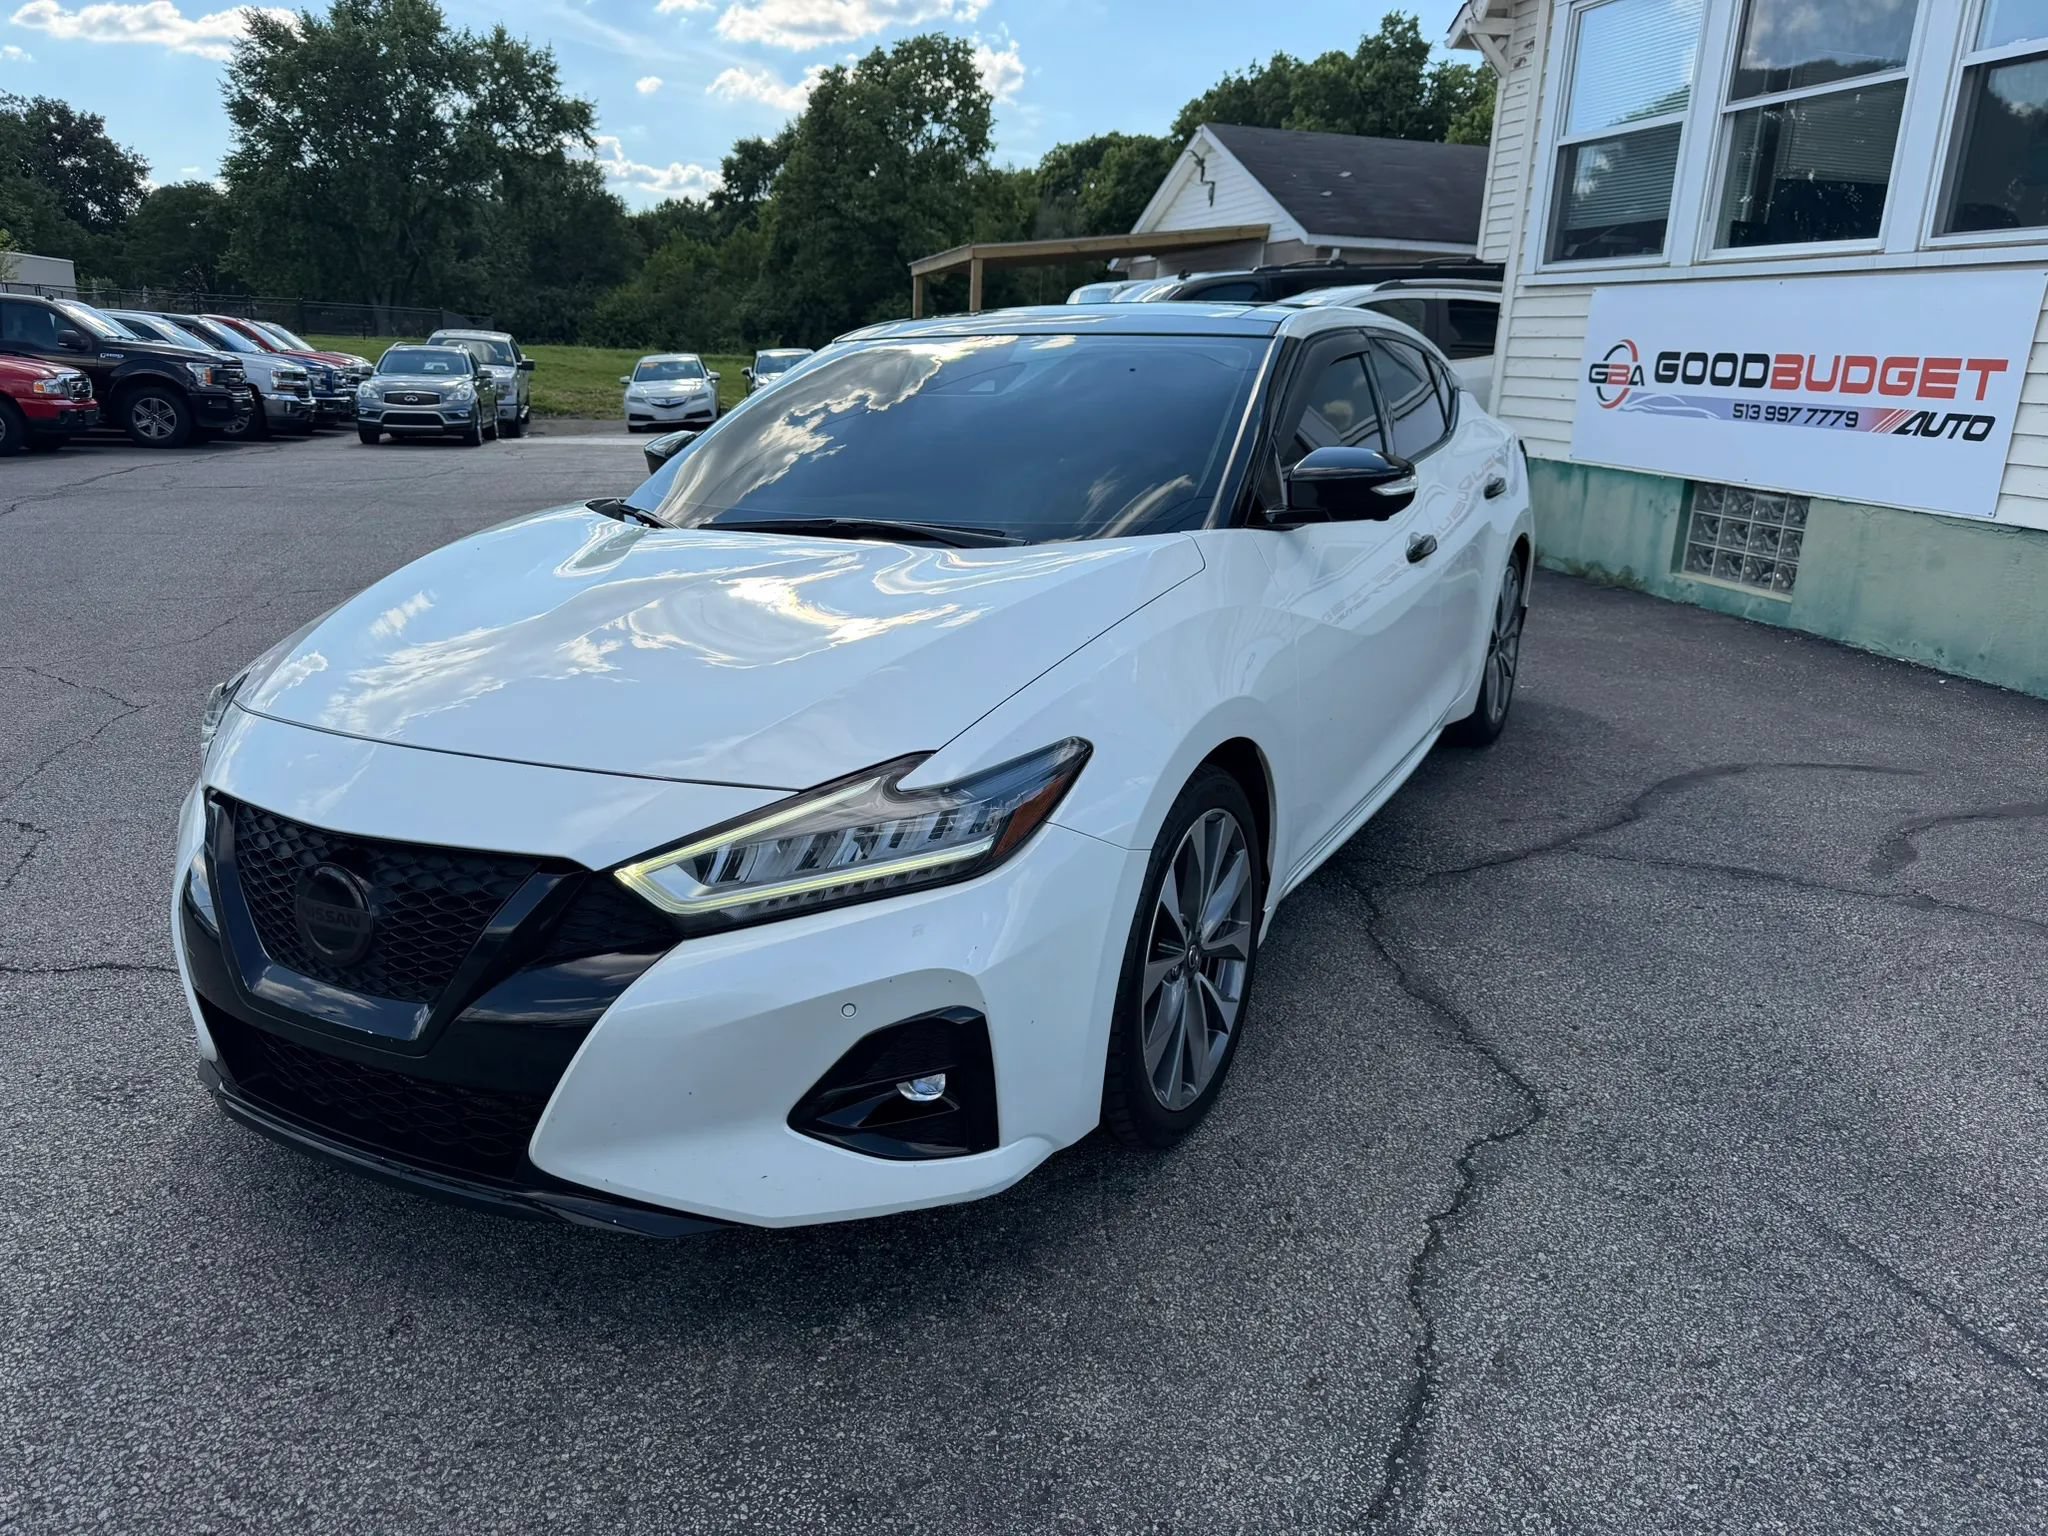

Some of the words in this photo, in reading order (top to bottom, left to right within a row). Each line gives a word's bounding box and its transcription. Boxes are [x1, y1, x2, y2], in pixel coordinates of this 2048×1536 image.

[1588, 364, 1645, 387] GBA
[1732, 403, 1761, 420] 513
[1764, 405, 1803, 423] 997
[1803, 408, 1859, 428] 7779
[1891, 410, 1996, 442] AUTO
